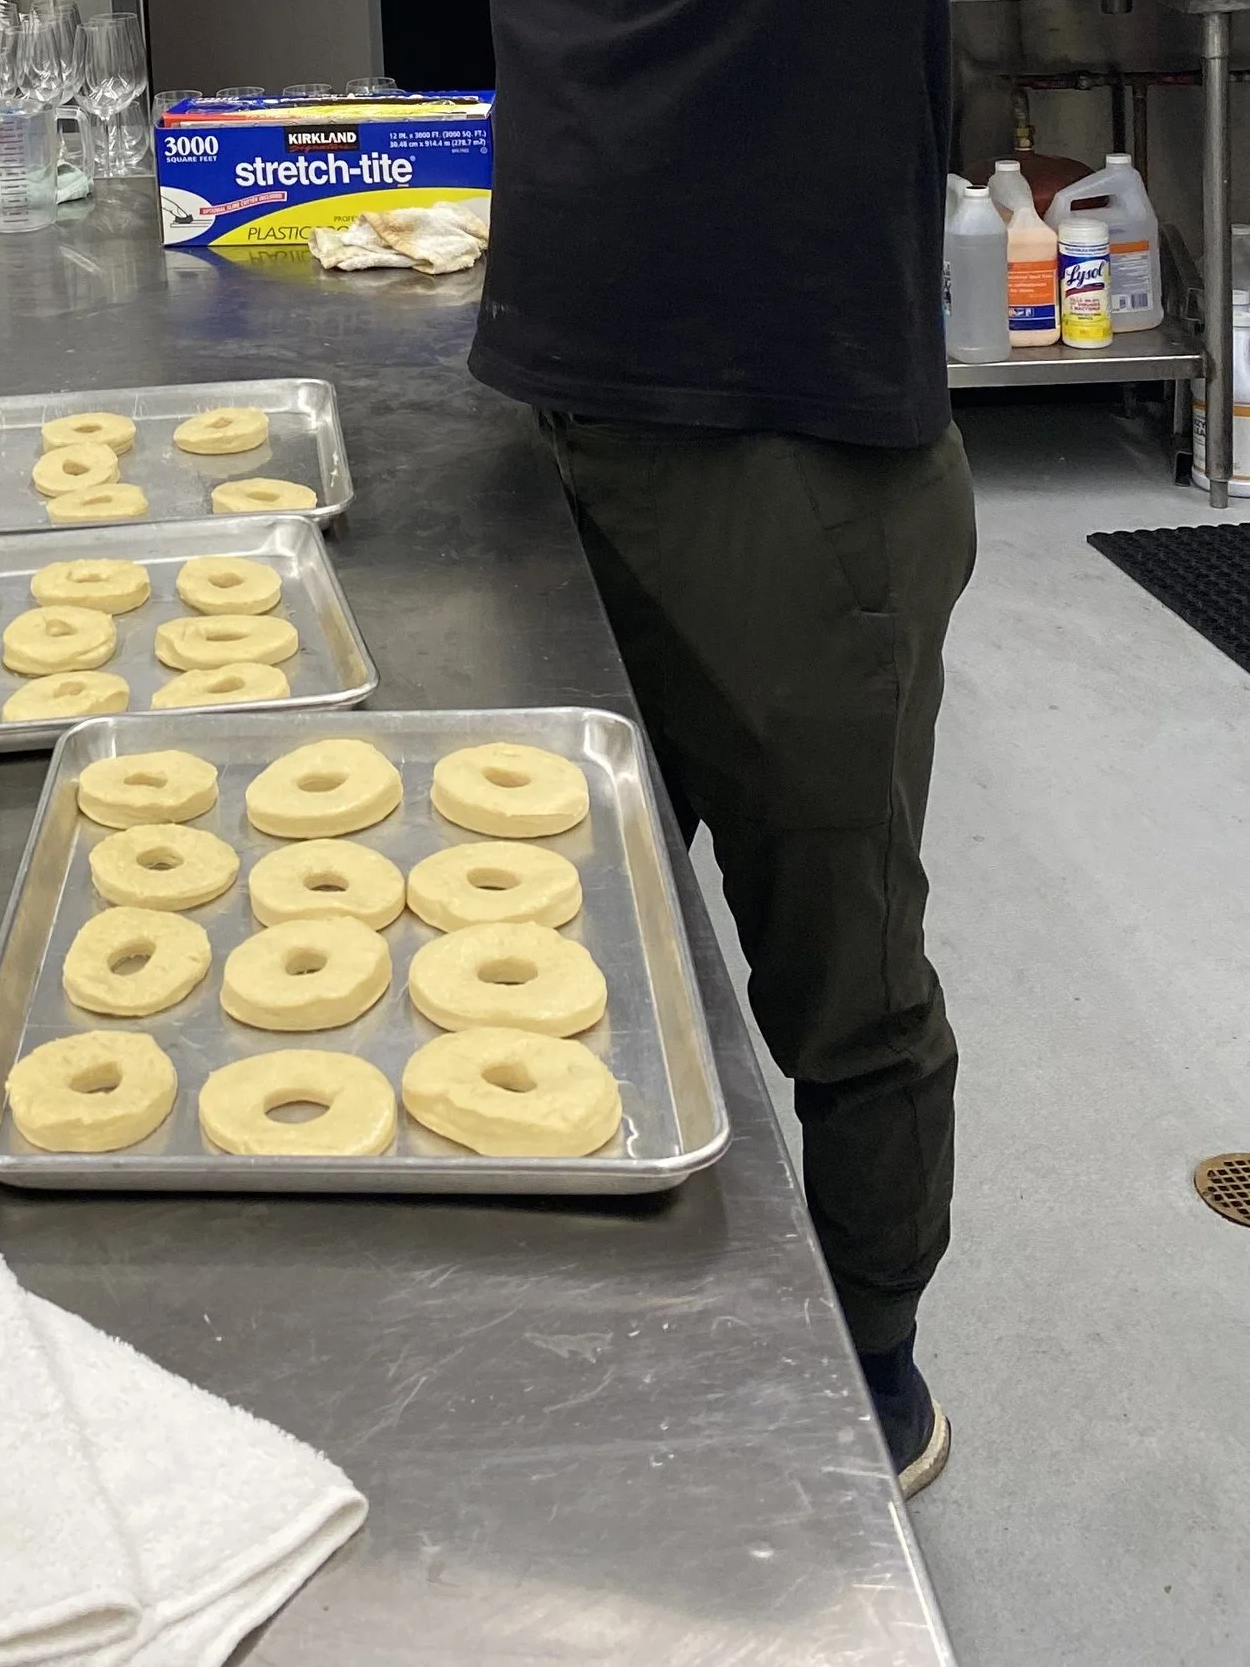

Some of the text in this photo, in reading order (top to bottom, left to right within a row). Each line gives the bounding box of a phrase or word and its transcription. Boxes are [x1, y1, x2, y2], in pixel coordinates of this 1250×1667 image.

[164, 135, 219, 156] 3000
[288, 132, 357, 145] KIRKLAND
[390, 140, 408, 148] 30.48
[424, 139, 443, 147] 914.4
[451, 138, 472, 148] (278.7
[199, 155, 218, 163] FEET
[235, 152, 413, 187] stretch-tite
[247, 226, 312, 241] PLASTIC
[1067, 261, 1105, 287] Lysol
